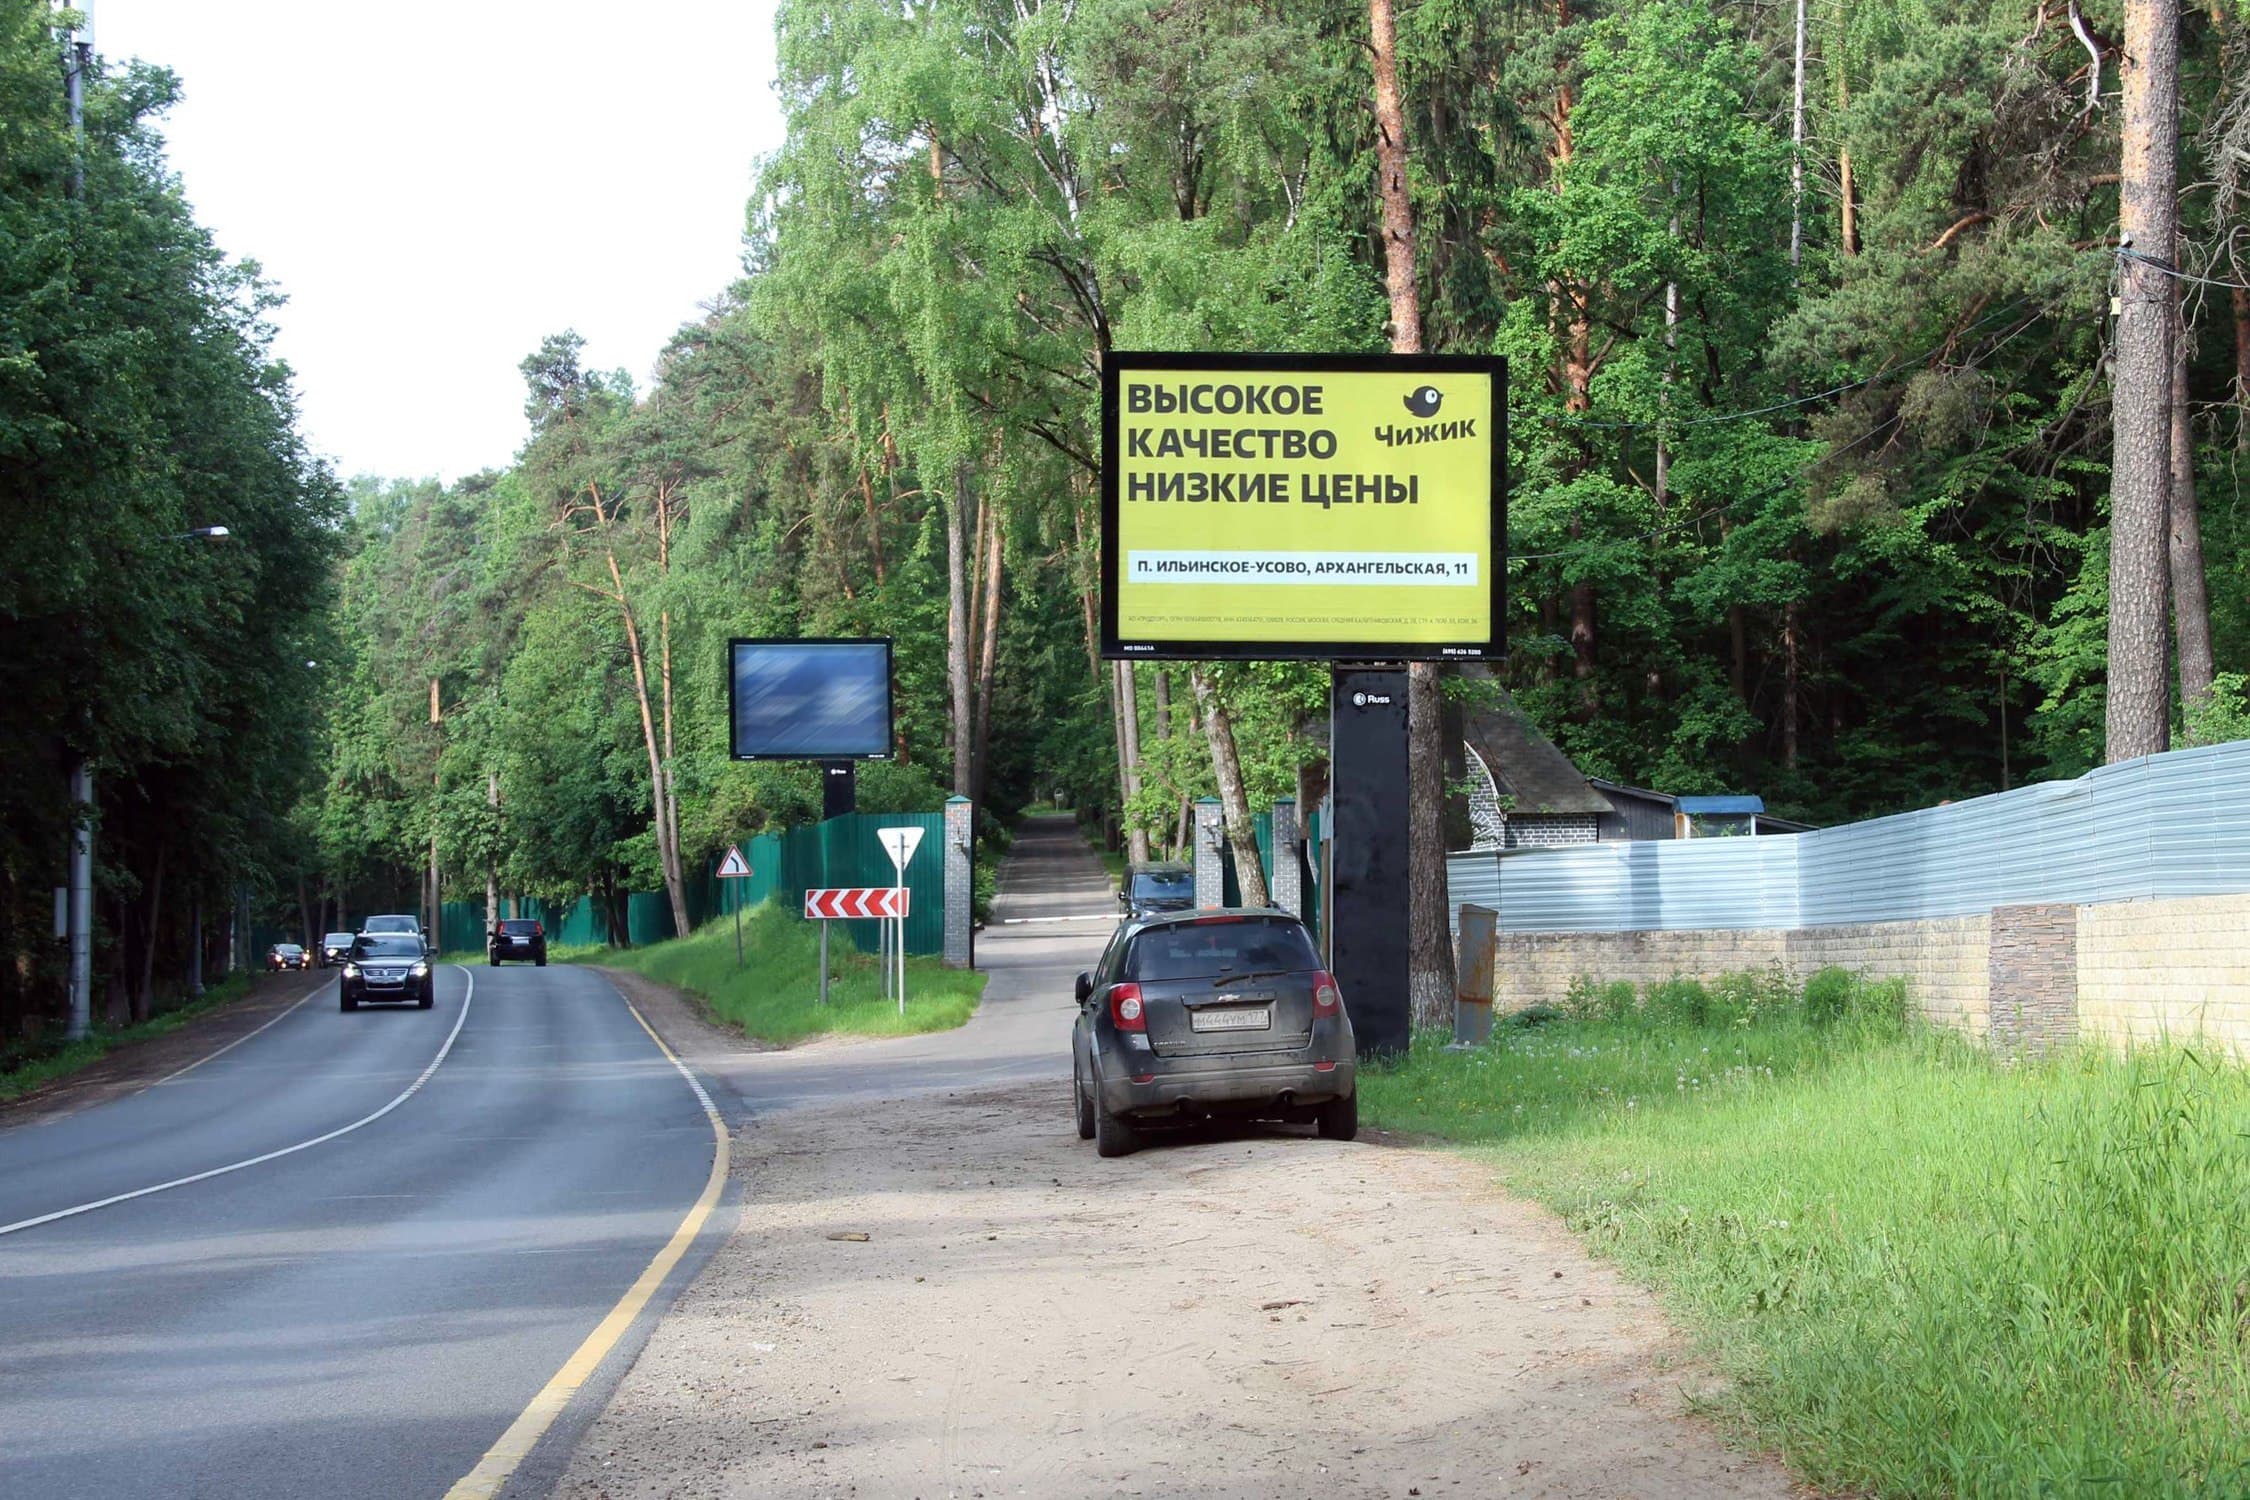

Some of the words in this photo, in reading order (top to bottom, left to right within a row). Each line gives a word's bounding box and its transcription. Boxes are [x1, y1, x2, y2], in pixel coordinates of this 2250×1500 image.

[1127, 384, 1323, 415] ВЫСОКОЕ
[1127, 428, 1337, 459] КАЧЕСТВО
[1374, 418, 1478, 447] Чижик
[1127, 472, 1290, 503] НИЗКИЕ
[1301, 474, 1418, 509] ЦЕНЫ
[1138, 560, 1153, 573] П.
[1157, 560, 1311, 576] ИЛЬИНСКОЕ-УСОВО,
[1315, 561, 1450, 577] АРХАНГЕЛЬСКАЯ,
[1454, 562, 1468, 575] 11
[1367, 694, 1390, 704] Russ
